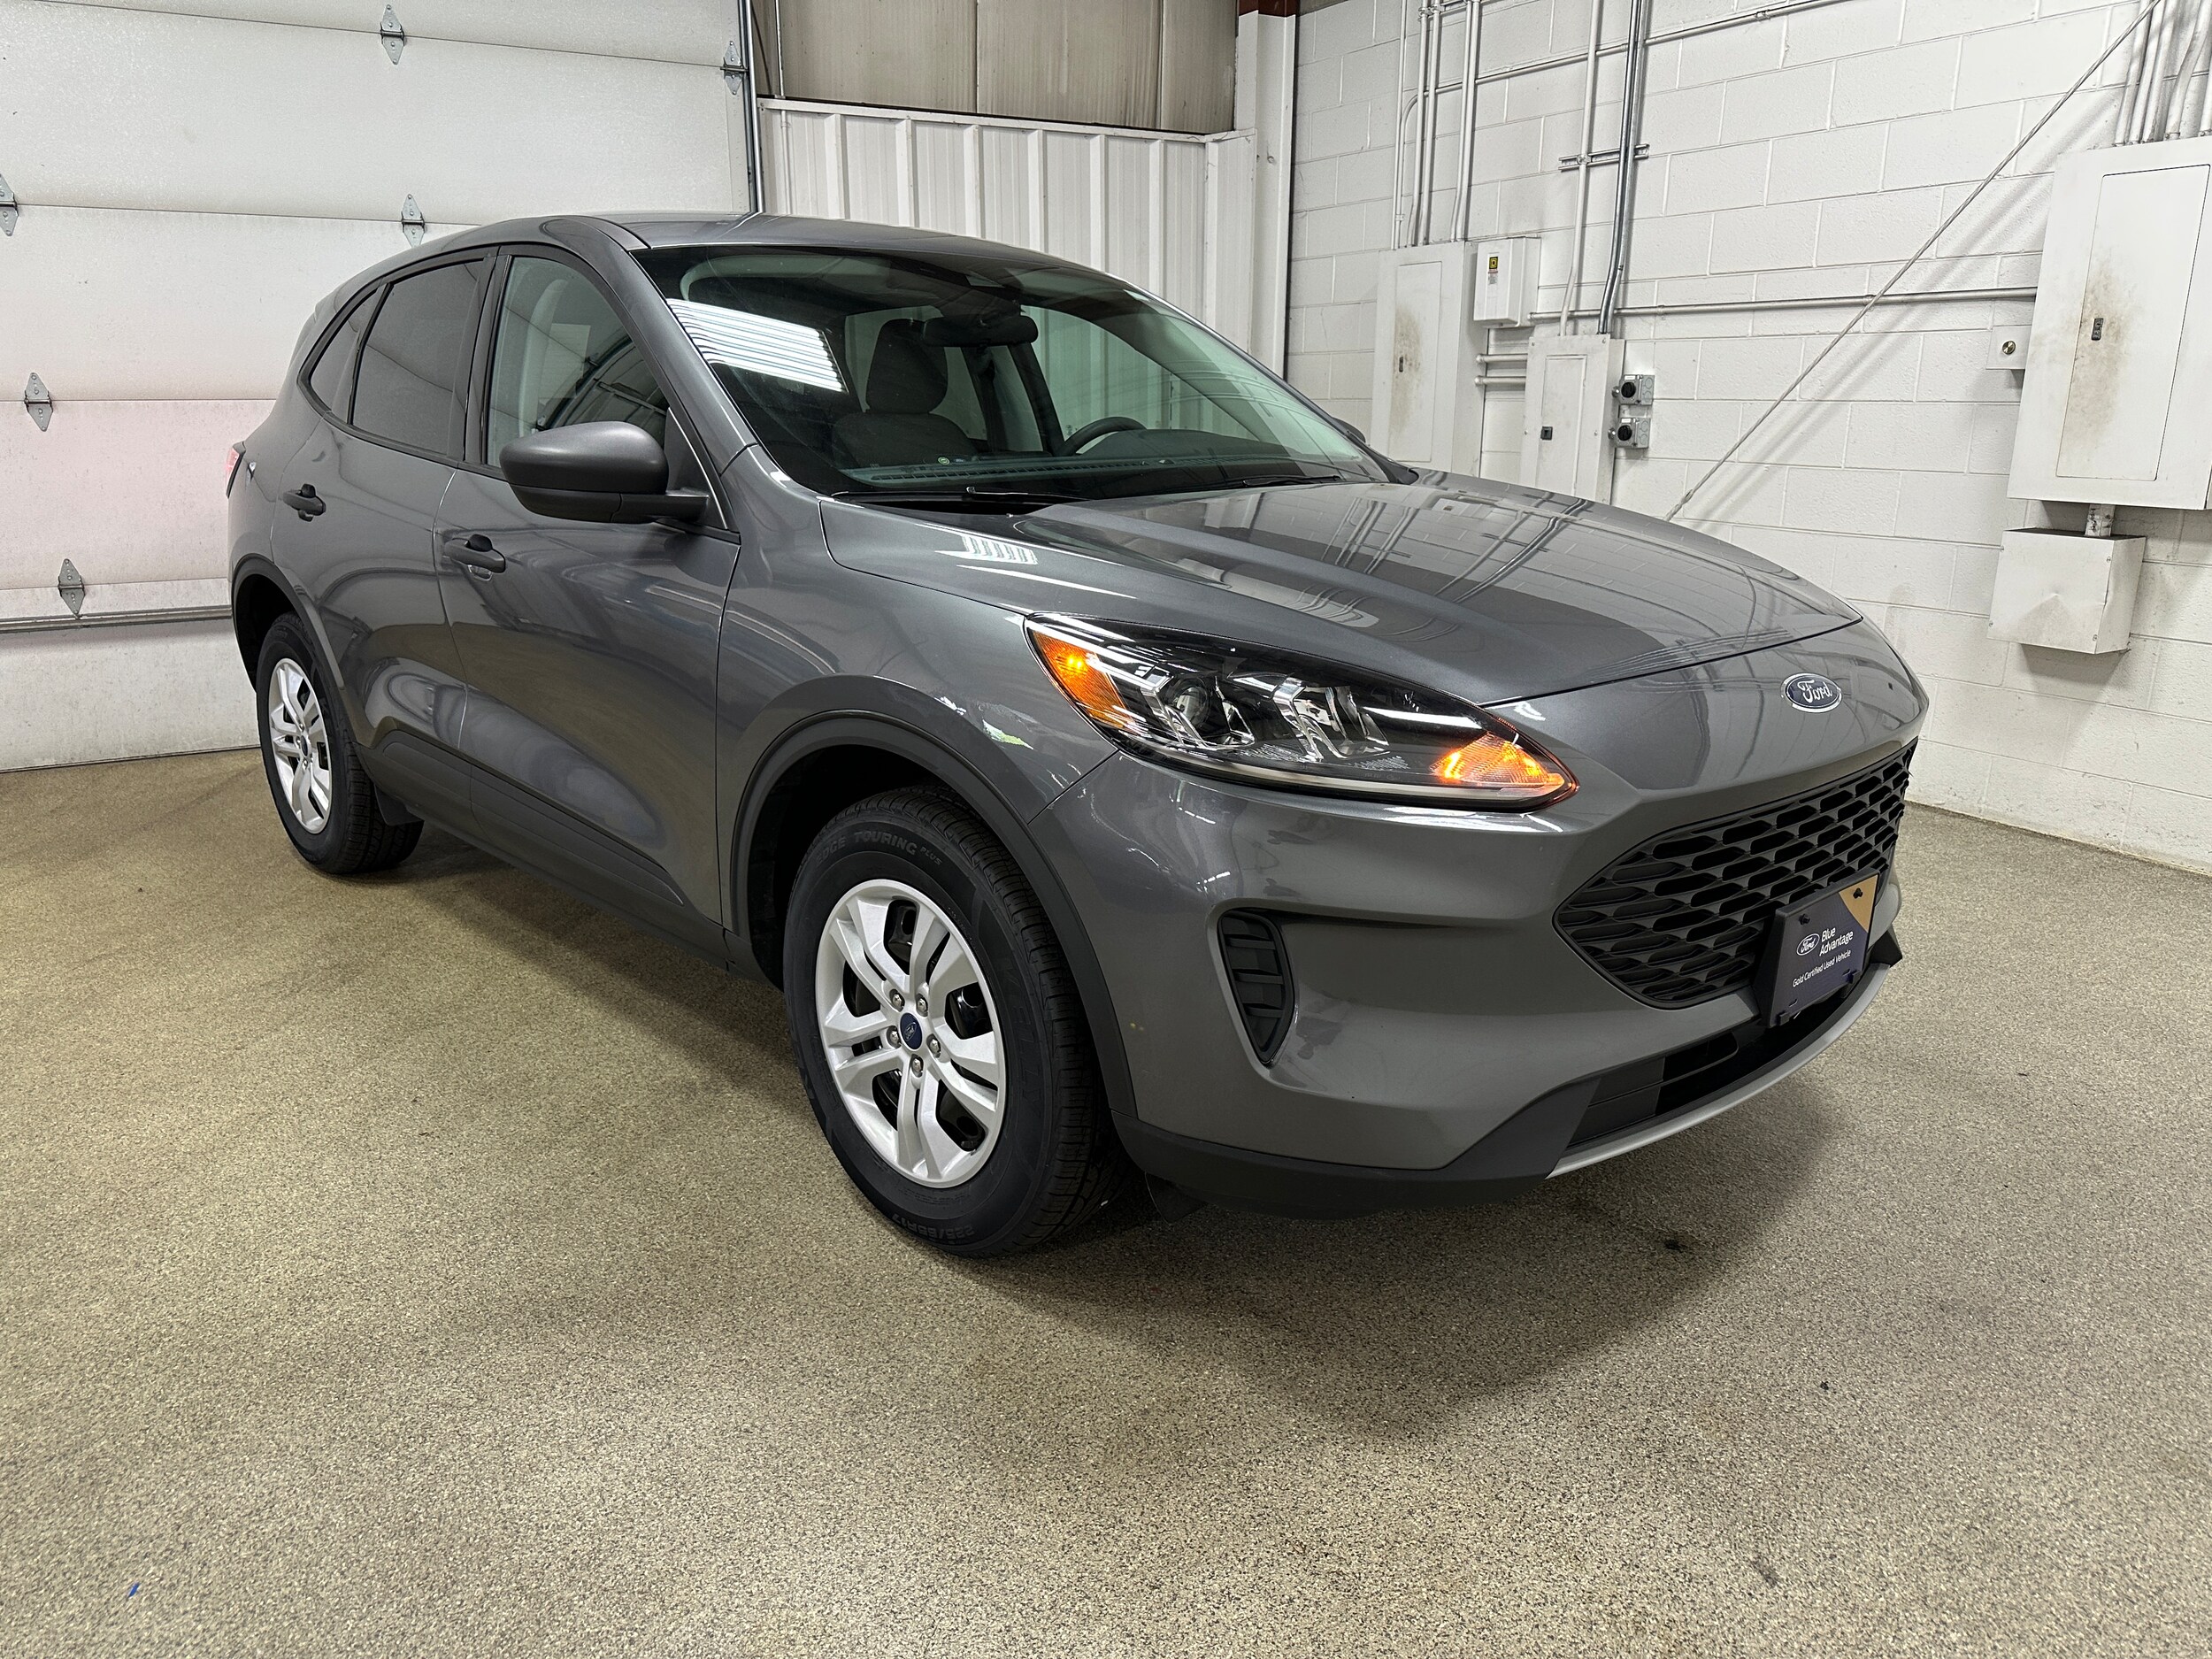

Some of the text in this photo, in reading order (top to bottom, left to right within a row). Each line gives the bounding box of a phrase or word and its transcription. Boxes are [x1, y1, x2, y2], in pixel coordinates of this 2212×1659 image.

[853, 830, 918, 856] TOURING
[920, 846, 942, 865] PLUS
[1819, 931, 1854, 957] Advantage
[1821, 926, 1836, 943] Blue
[1793, 949, 1851, 987] Gold Certified Used Vehicle
